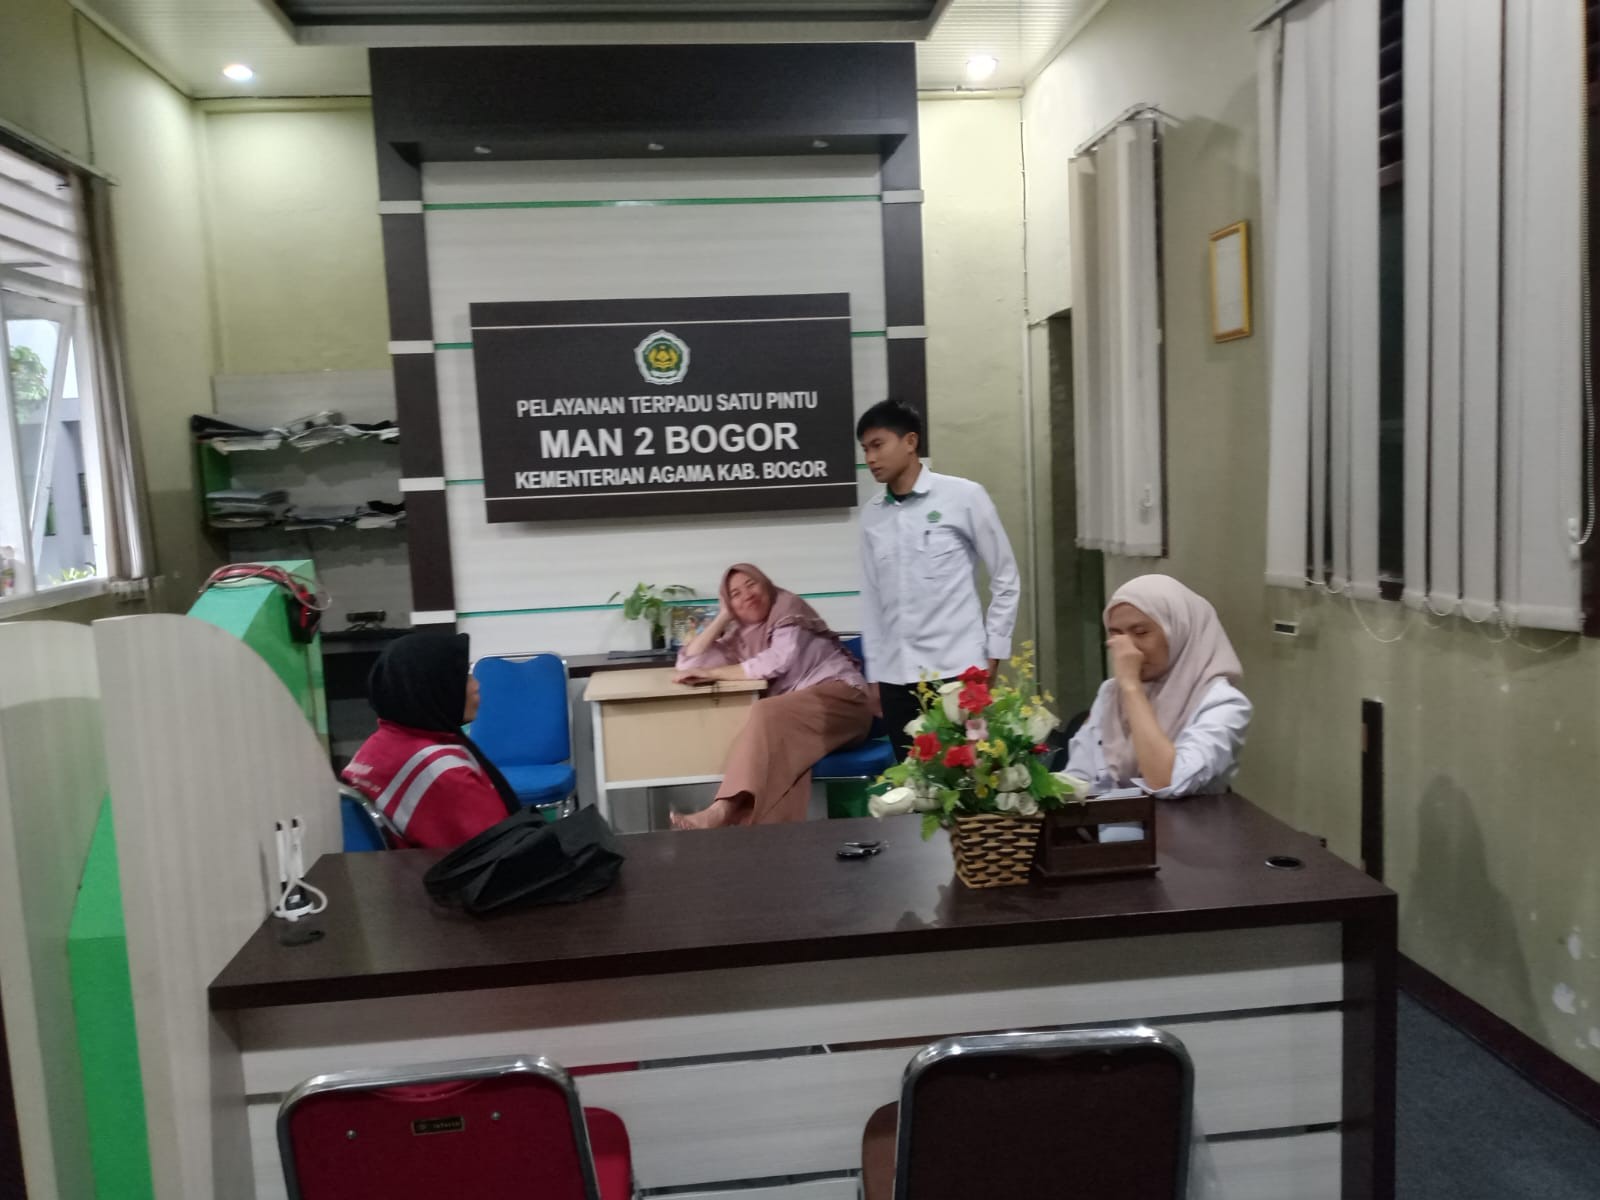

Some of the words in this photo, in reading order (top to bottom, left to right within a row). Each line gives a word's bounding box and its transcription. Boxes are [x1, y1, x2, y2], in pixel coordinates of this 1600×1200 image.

[516, 396, 626, 418] PELAYANAN
[629, 394, 713, 415] TERPADU
[716, 393, 762, 412] SATU
[766, 391, 818, 410] PINTU
[540, 428, 624, 459] MAN
[635, 427, 655, 455] 2
[665, 422, 799, 455] BOGOR
[515, 467, 645, 489] KEMENTERIAN
[648, 464, 715, 484] AGAMA
[717, 463, 760, 481] KAB.
[763, 460, 827, 479] BOGOR
